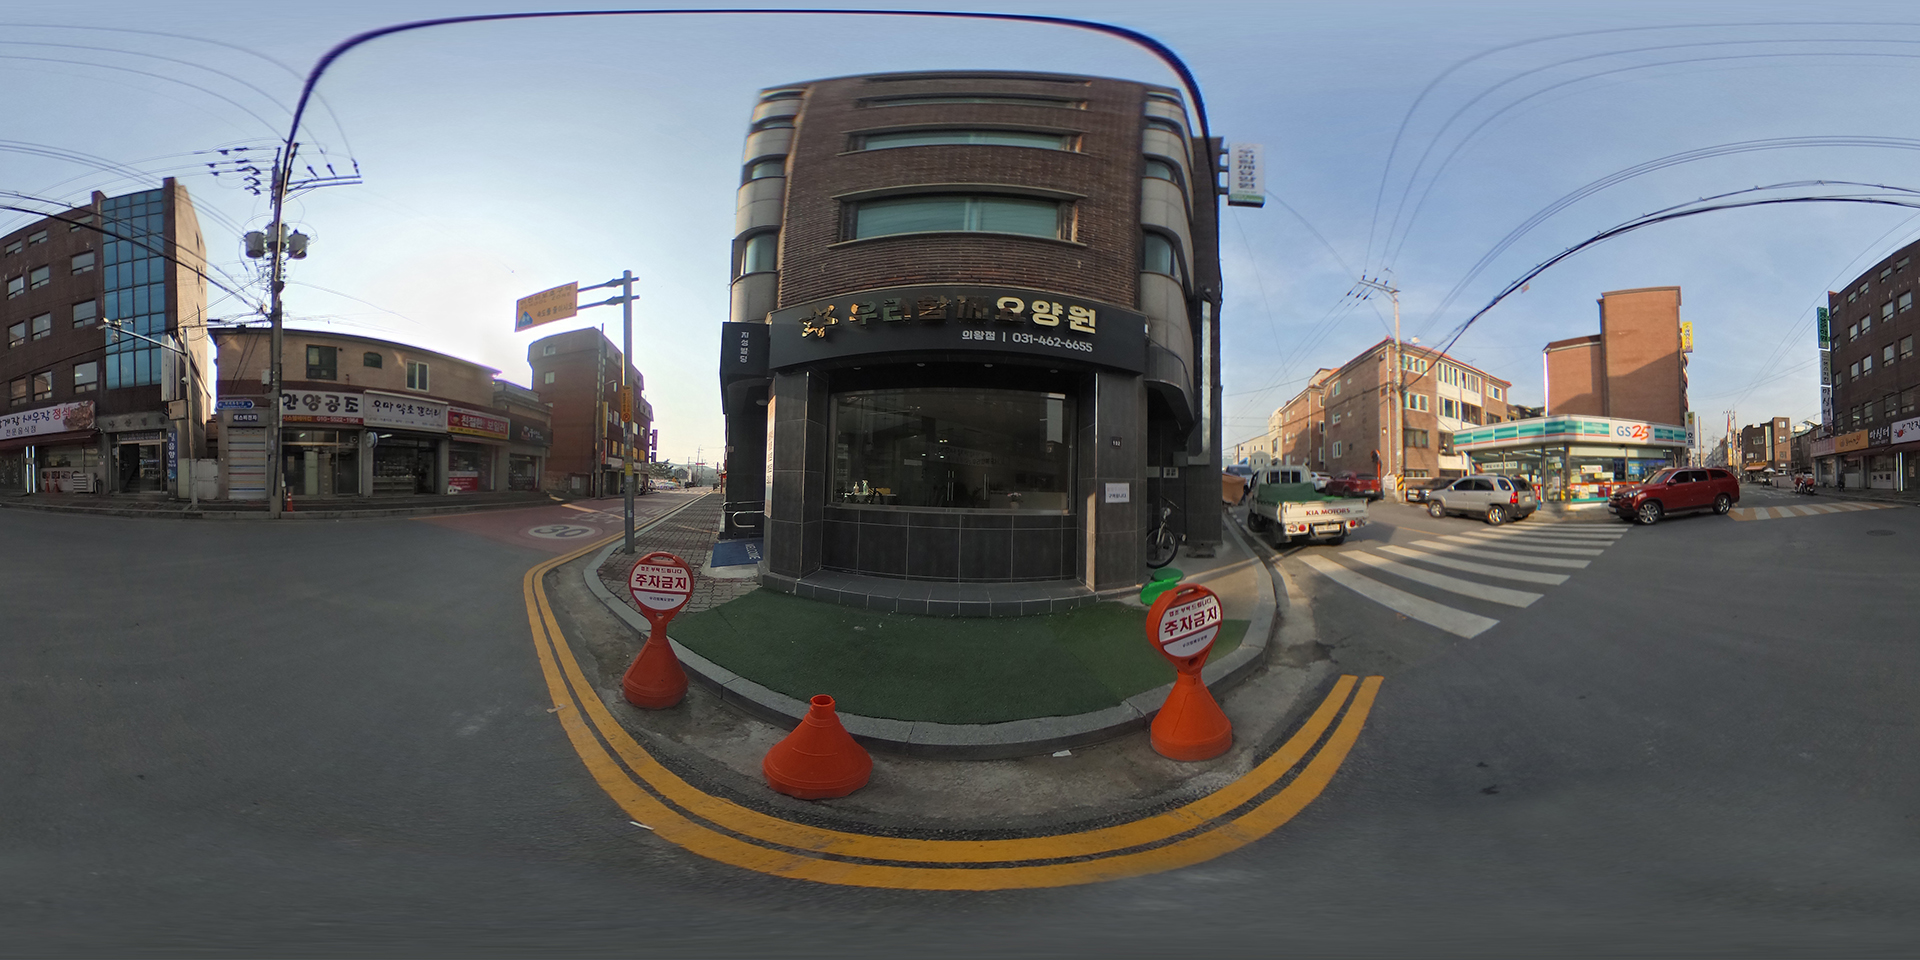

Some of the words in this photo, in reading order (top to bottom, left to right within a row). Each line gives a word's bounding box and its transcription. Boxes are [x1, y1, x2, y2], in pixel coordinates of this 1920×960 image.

[962, 330, 996, 341] 의왕점
[1012, 332, 1093, 353] 031-462-6655
[282, 393, 359, 413] 안양공조
[0, 416, 20, 429] 게장
[53, 406, 72, 421] 정식
[487, 420, 506, 433] 보일러
[533, 525, 590, 538] 30
[635, 573, 687, 590] 주차금지
[1164, 605, 1218, 636] 주차금지
